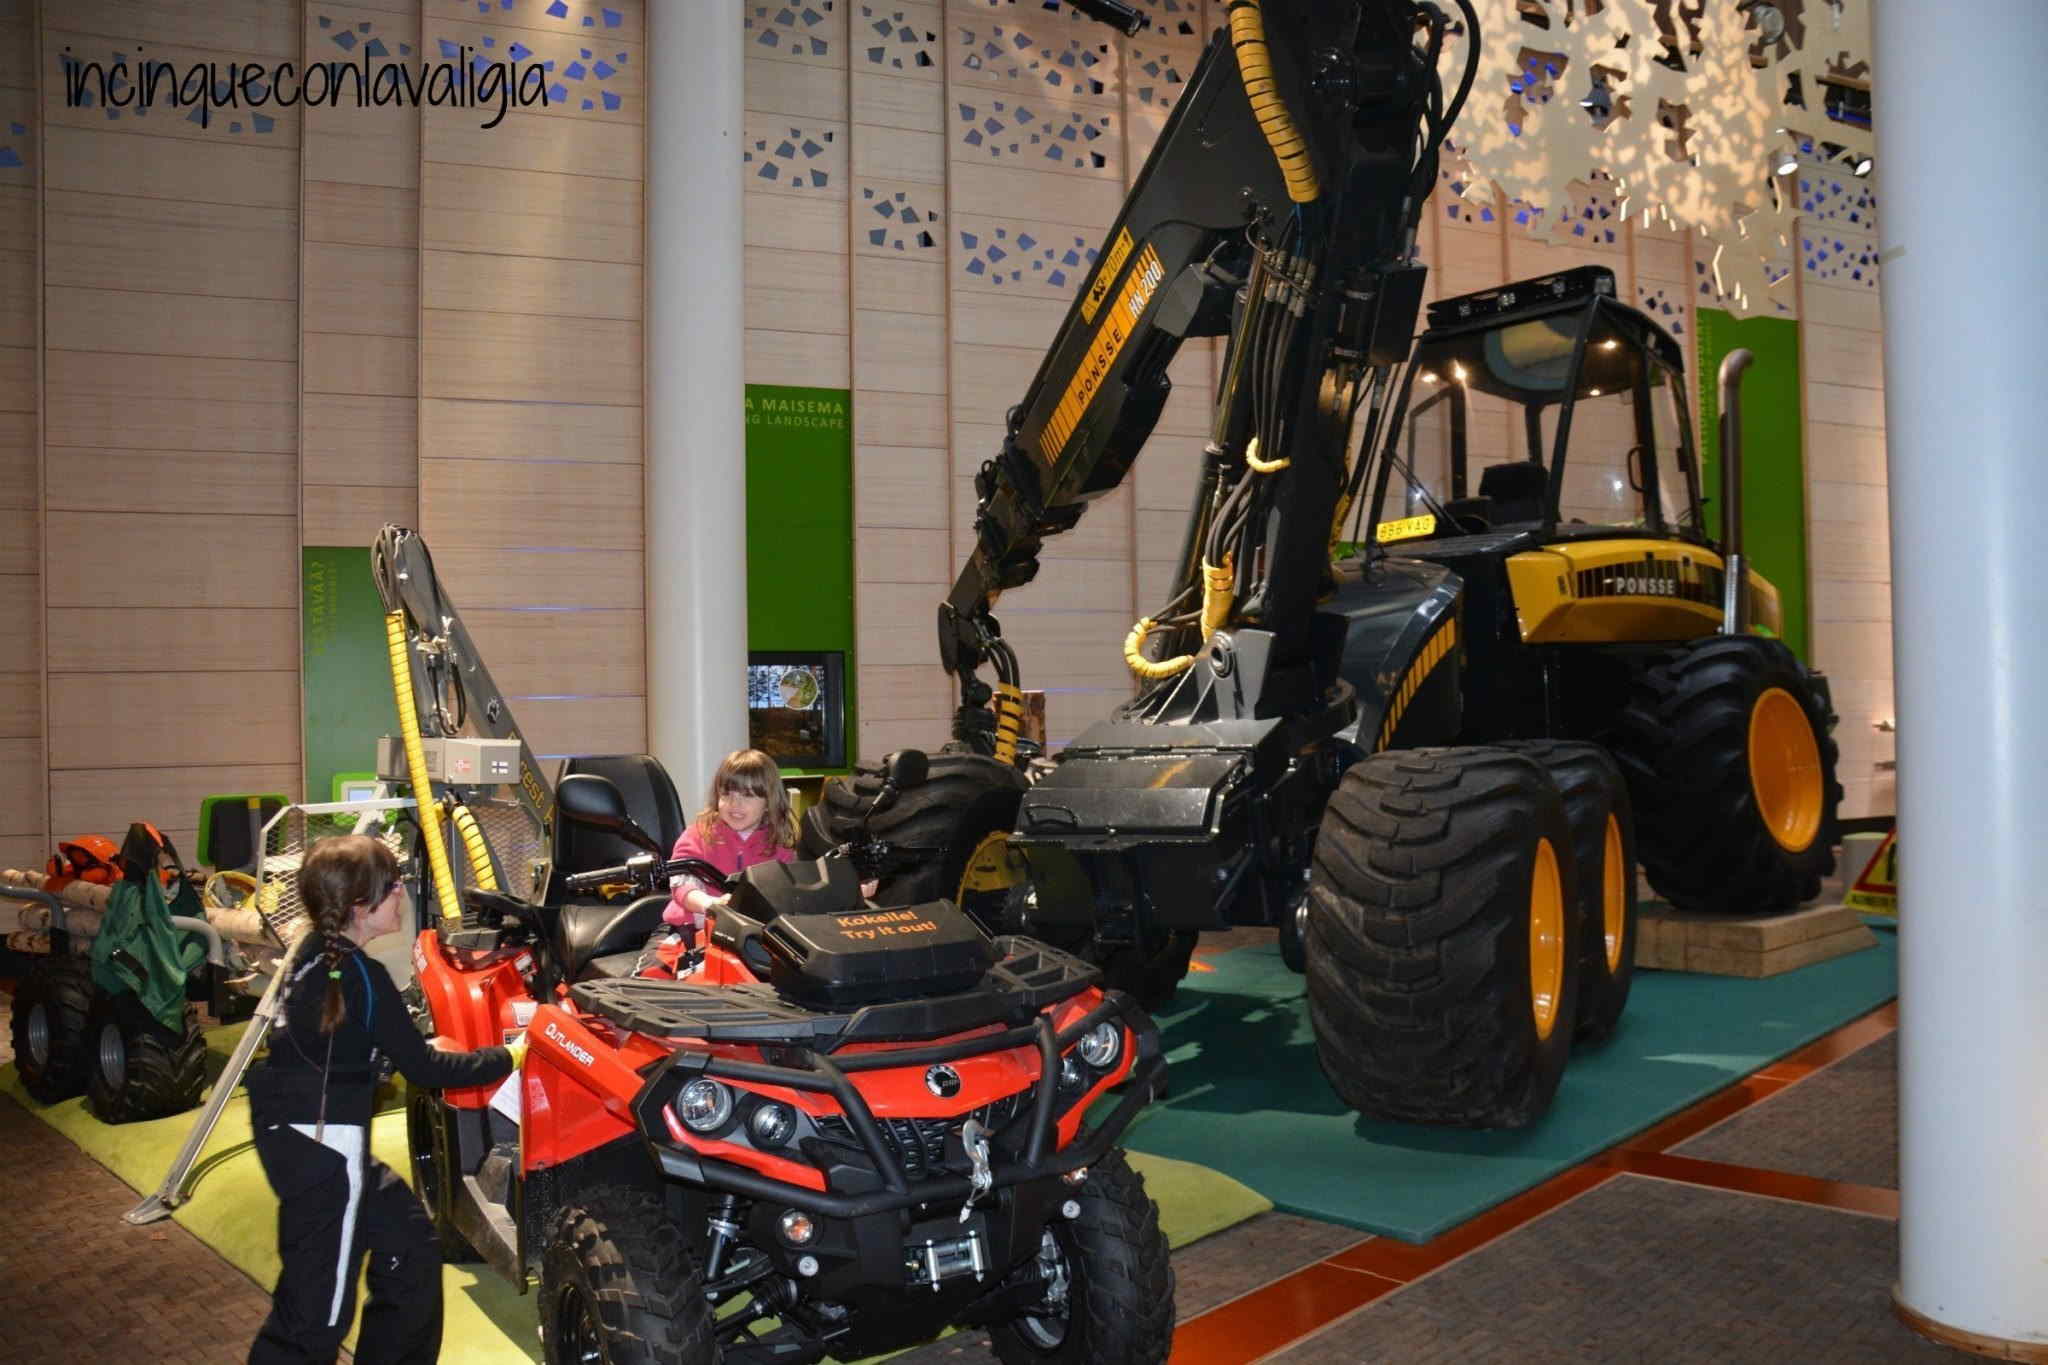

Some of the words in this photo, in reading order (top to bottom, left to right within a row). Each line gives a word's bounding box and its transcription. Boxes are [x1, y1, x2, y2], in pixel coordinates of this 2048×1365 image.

[1077, 328, 1122, 404] PONSSE
[1141, 260, 1163, 296] 200
[762, 399, 843, 415] MAISEMA
[767, 415, 844, 430] LANDSCAPE
[1616, 577, 1676, 595] PONSSE
[836, 910, 919, 928] Kokeile!
[840, 928, 877, 940] Try
[878, 924, 897, 936] it
[898, 920, 938, 934] out!
